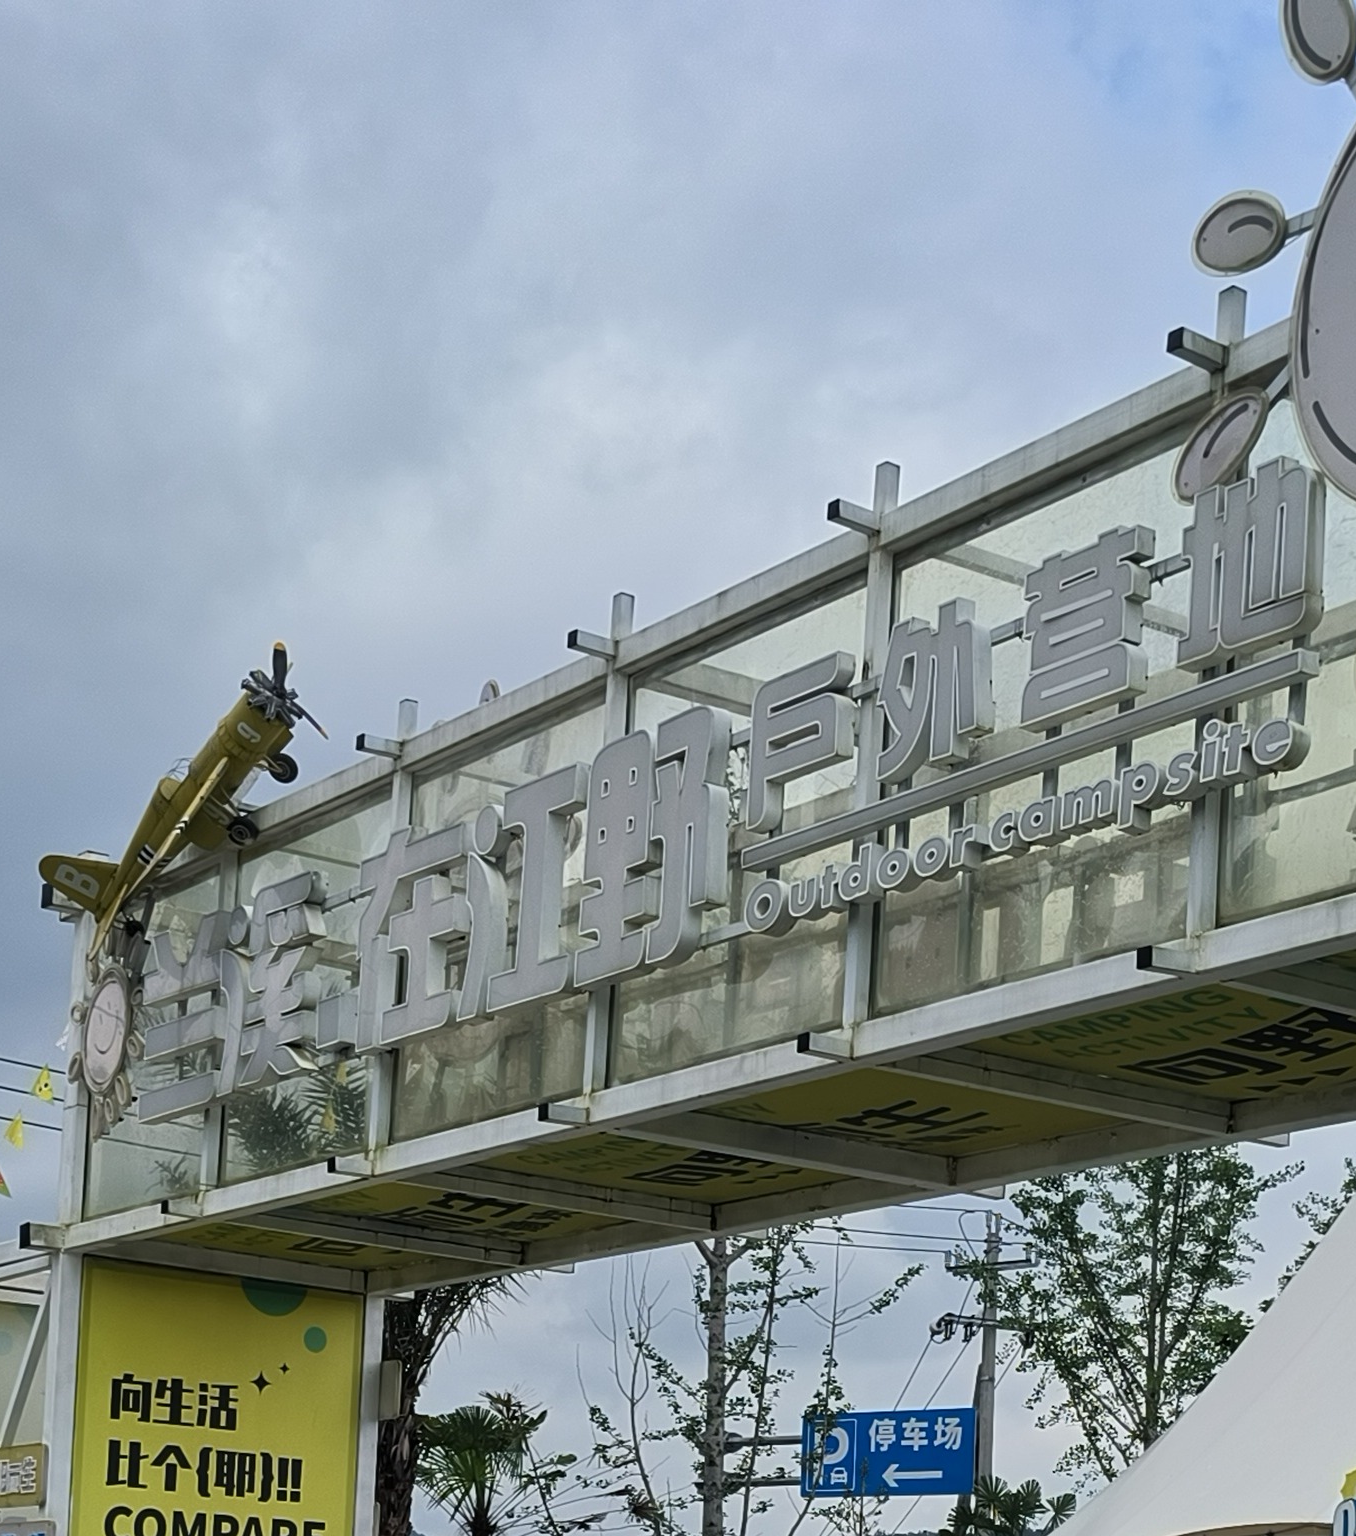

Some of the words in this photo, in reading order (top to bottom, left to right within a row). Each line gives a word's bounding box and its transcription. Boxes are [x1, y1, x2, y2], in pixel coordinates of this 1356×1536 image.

[743, 455, 1327, 832] 户外营地
[745, 824, 977, 934] Outdoor
[988, 715, 1295, 852] campsite
[53, 863, 100, 900] B
[998, 988, 1235, 1047] CAMPING
[108, 1372, 240, 1432] 向生活
[867, 1417, 963, 1453] 停车场
